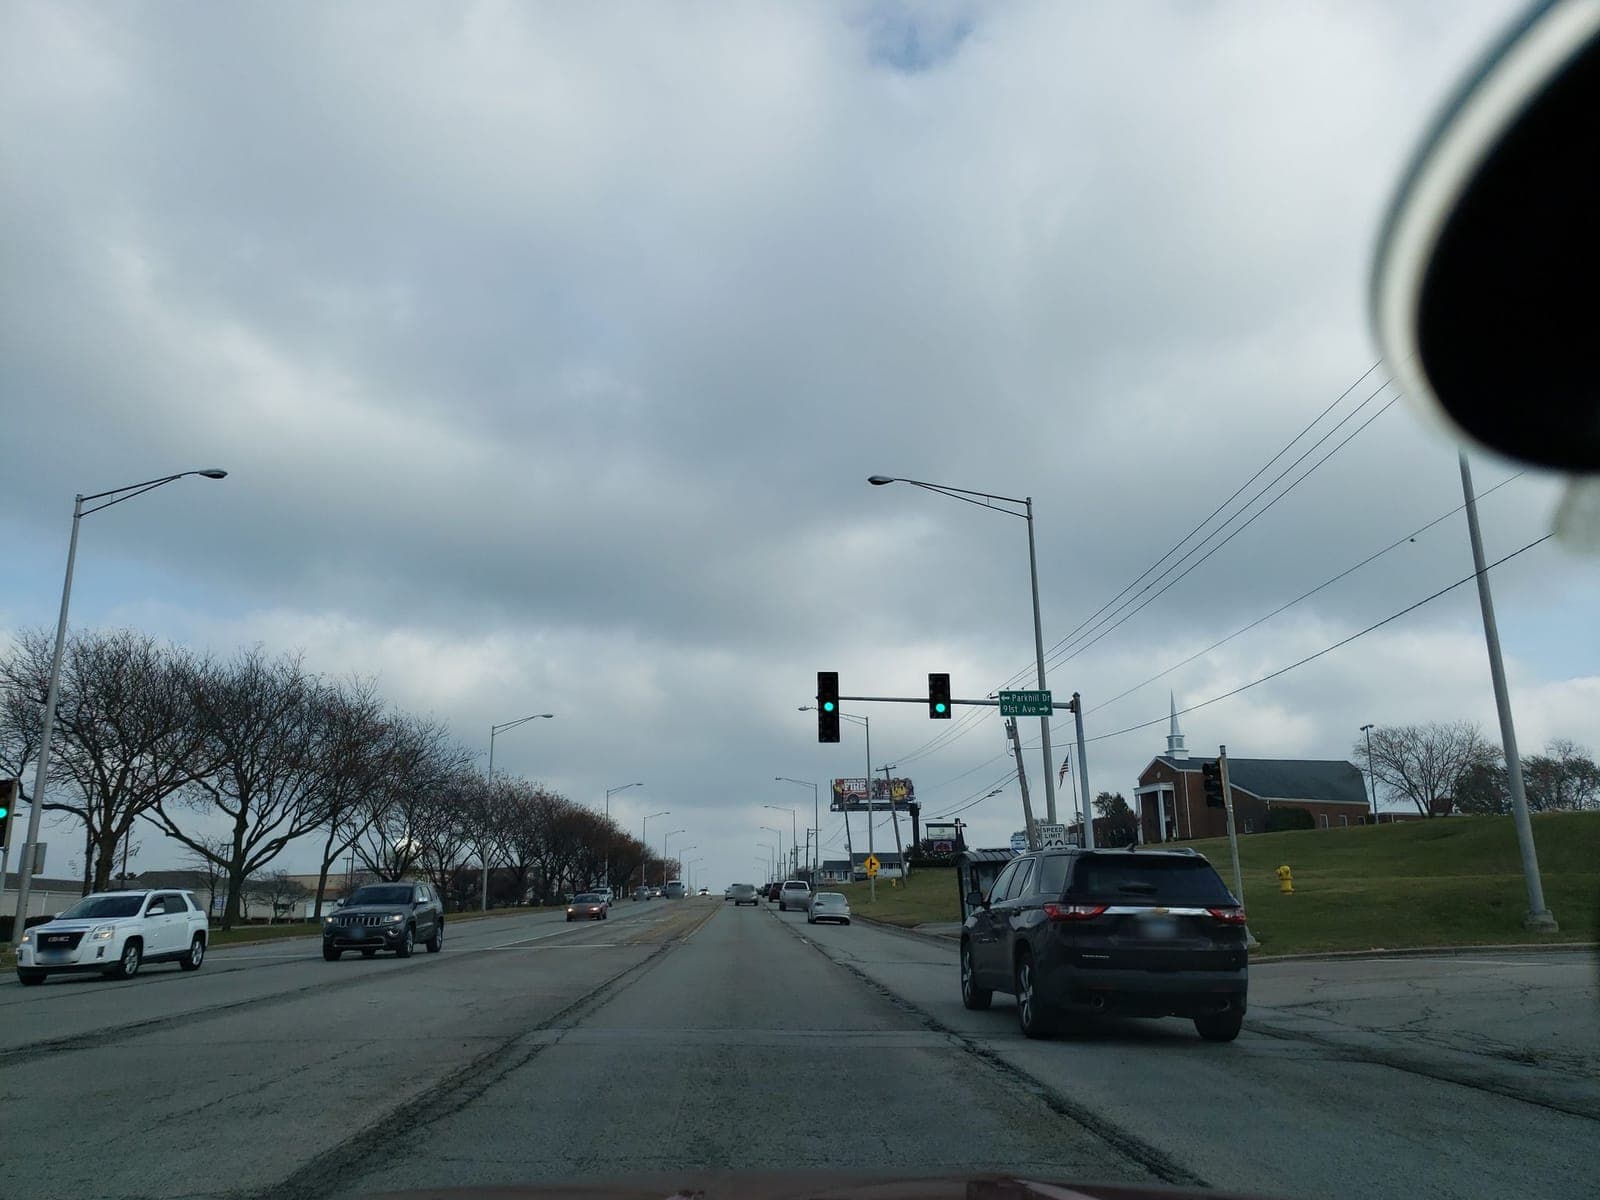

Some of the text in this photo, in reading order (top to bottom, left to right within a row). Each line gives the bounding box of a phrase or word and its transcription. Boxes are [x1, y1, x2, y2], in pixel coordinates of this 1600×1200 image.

[1011, 693, 1050, 702] Parkhill Dr
[1003, 705, 1036, 713] 91st Ave
[844, 782, 866, 791] FIRE
